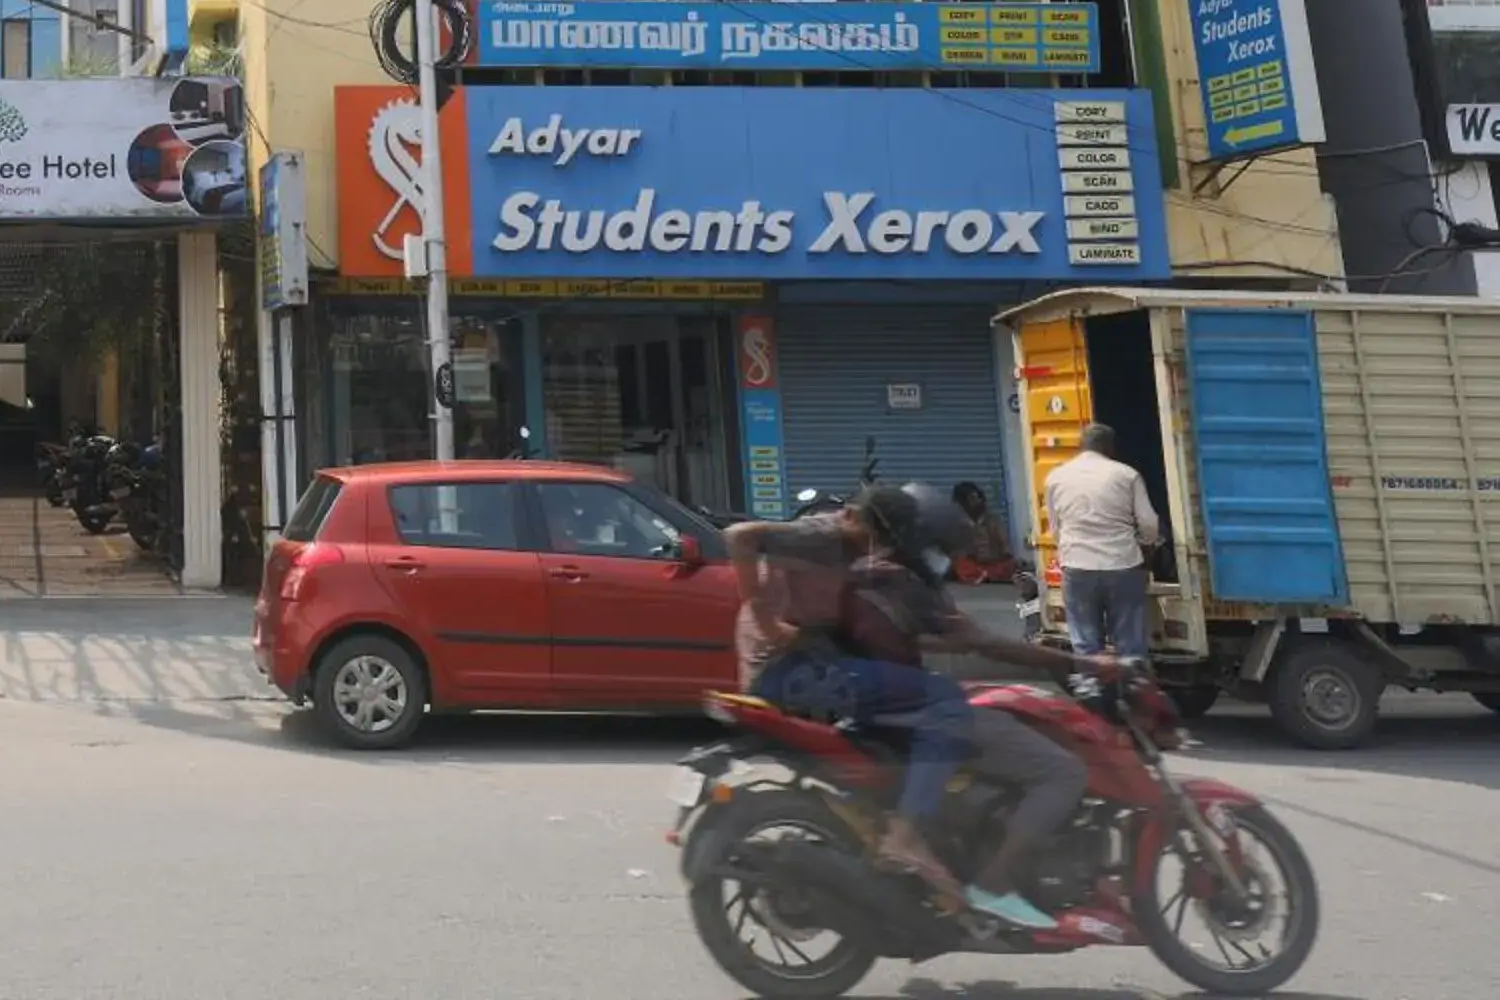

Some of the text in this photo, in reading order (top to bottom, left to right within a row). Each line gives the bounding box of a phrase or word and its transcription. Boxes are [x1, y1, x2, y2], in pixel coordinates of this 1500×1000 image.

[491, 11, 919, 60] மாணவர் நகலகம்
[1202, 6, 1272, 45] Students
[1227, 35, 1276, 64] Xerox
[1075, 107, 1108, 118] COPY
[488, 114, 642, 166] Adyar
[1075, 129, 1112, 141] PRINT
[43, 153, 116, 179] Hotel
[1076, 153, 1117, 163] COLOR
[1082, 176, 1117, 187] SCAN
[492, 187, 1047, 256] Students Xerox
[1078, 248, 1135, 260] LAMINATE
